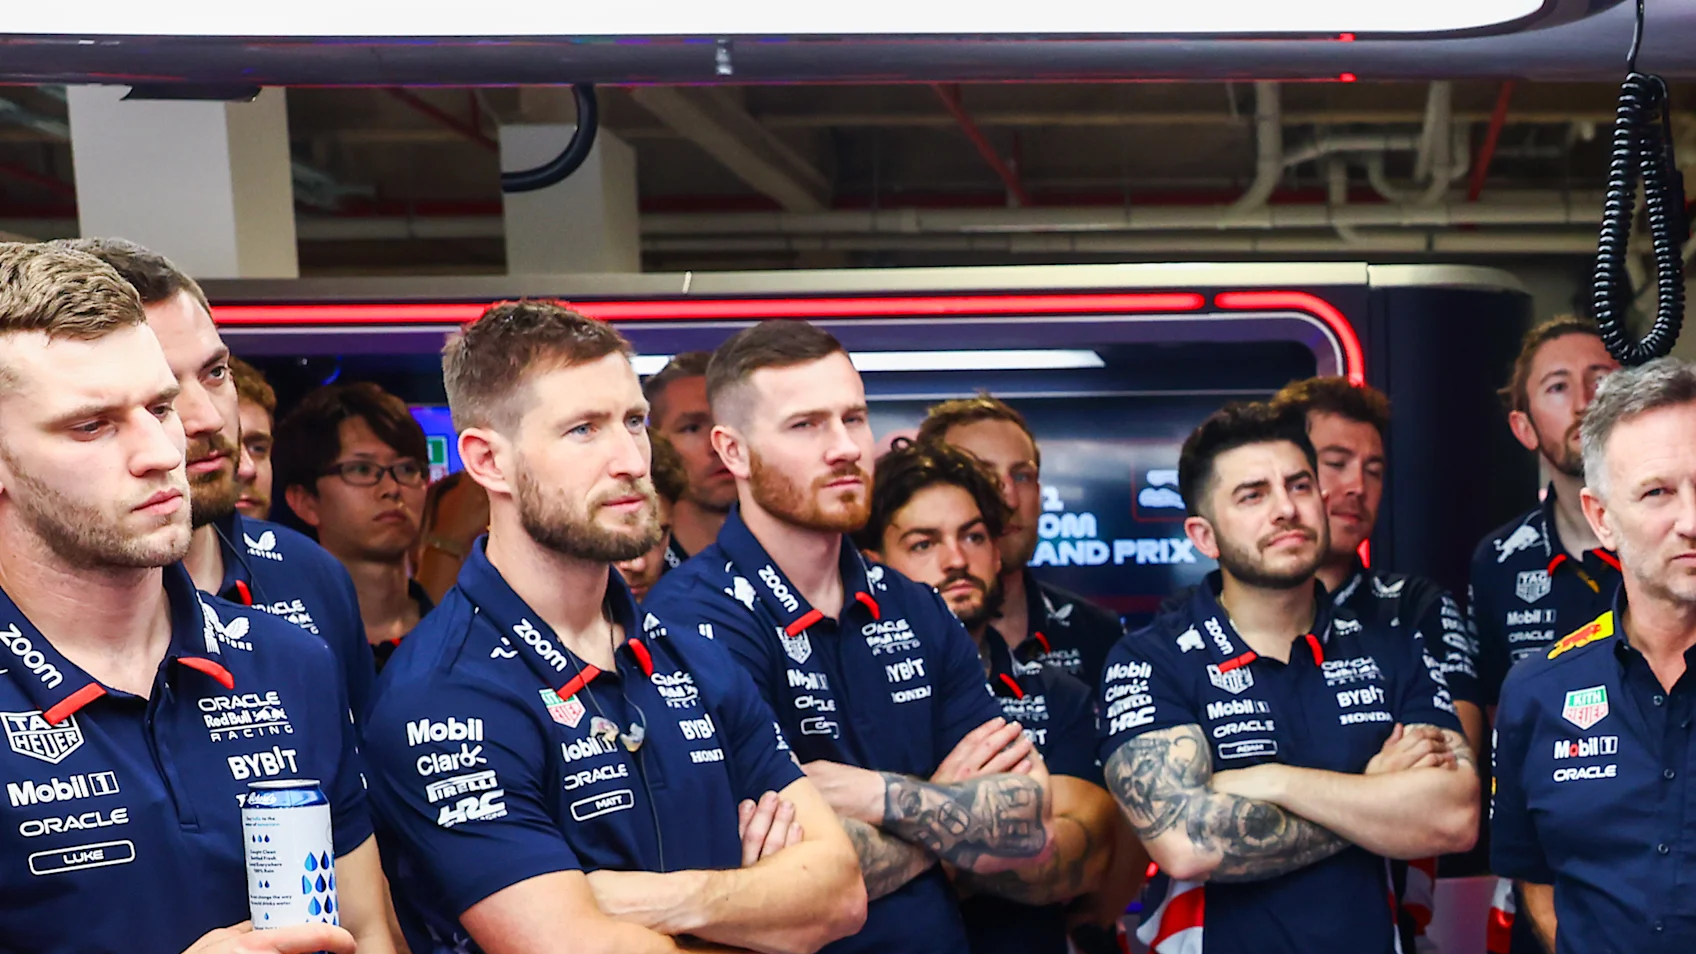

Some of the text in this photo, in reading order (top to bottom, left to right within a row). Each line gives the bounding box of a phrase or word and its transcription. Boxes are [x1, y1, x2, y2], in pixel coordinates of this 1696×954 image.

[1038, 512, 1097, 538] OM
[1027, 538, 1197, 567] AND PRIX
[758, 565, 799, 612] zoom
[1506, 609, 1541, 626] Mobil
[512, 617, 568, 672] zoom
[1204, 616, 1235, 656] zoom
[1508, 629, 1555, 643] ORACLE
[0, 622, 64, 690] zoom
[1105, 661, 1152, 684] Mobil
[198, 690, 281, 713] ORACLE
[1336, 684, 1385, 708] BYBIT
[1573, 688, 1605, 707] KITH
[1206, 699, 1255, 720] Mobil
[1564, 702, 1607, 728] HEUER
[210, 724, 294, 743] RACING
[406, 717, 484, 747] Mobil
[678, 713, 715, 741] BYBI
[1213, 719, 1275, 739] ORACLE
[15, 729, 79, 759] HEUER
[690, 748, 724, 764] HON
[1553, 735, 1599, 760] Mobil
[227, 745, 299, 781] BYBIT
[416, 743, 488, 776] Claro
[425, 769, 498, 803] PIRELLI
[1553, 763, 1617, 783] ORACLE
[7, 774, 89, 807] Mobil
[595, 795, 623, 809] MATT
[437, 789, 506, 827] HRC
[19, 807, 129, 838] ORACLE
[63, 849, 105, 866] LUKE
